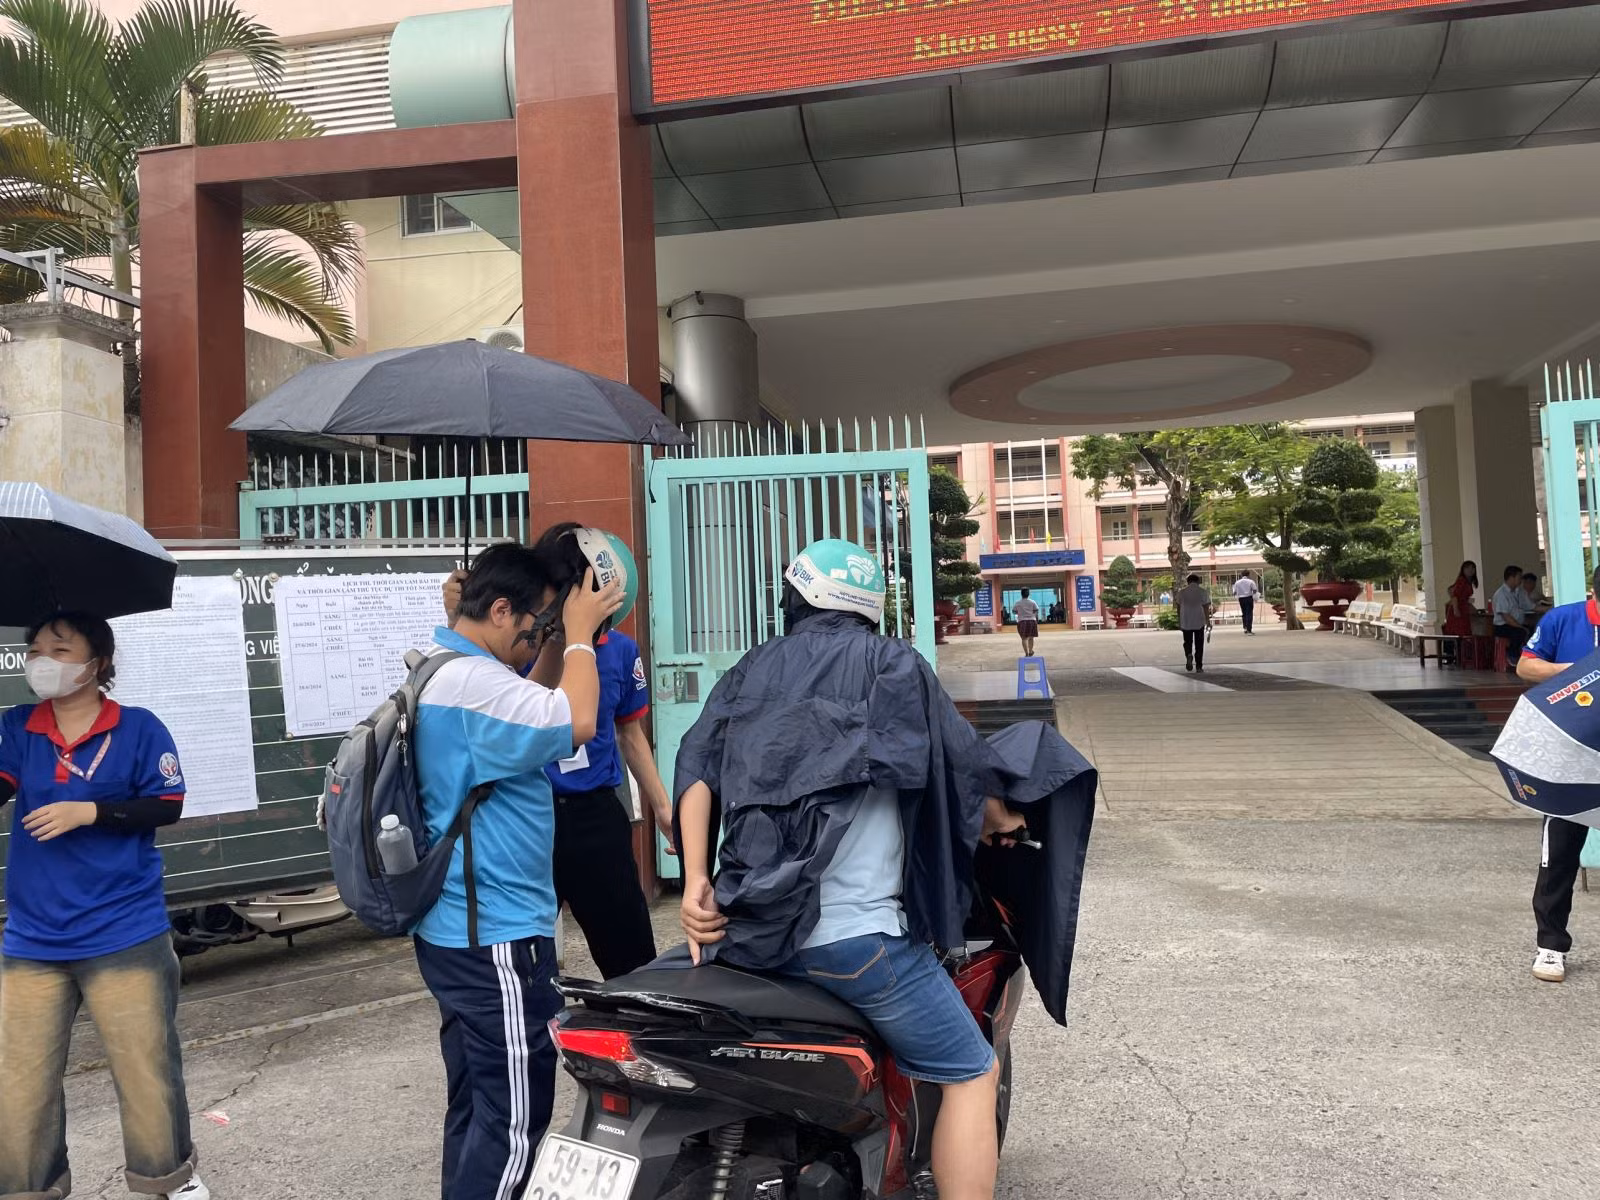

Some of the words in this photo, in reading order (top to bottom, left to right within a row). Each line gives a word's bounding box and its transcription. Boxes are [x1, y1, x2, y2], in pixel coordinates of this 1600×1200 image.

[260, 635, 281, 658] VIỆ
[0, 647, 27, 670] ÒN
[596, 1123, 626, 1136] HONDA
